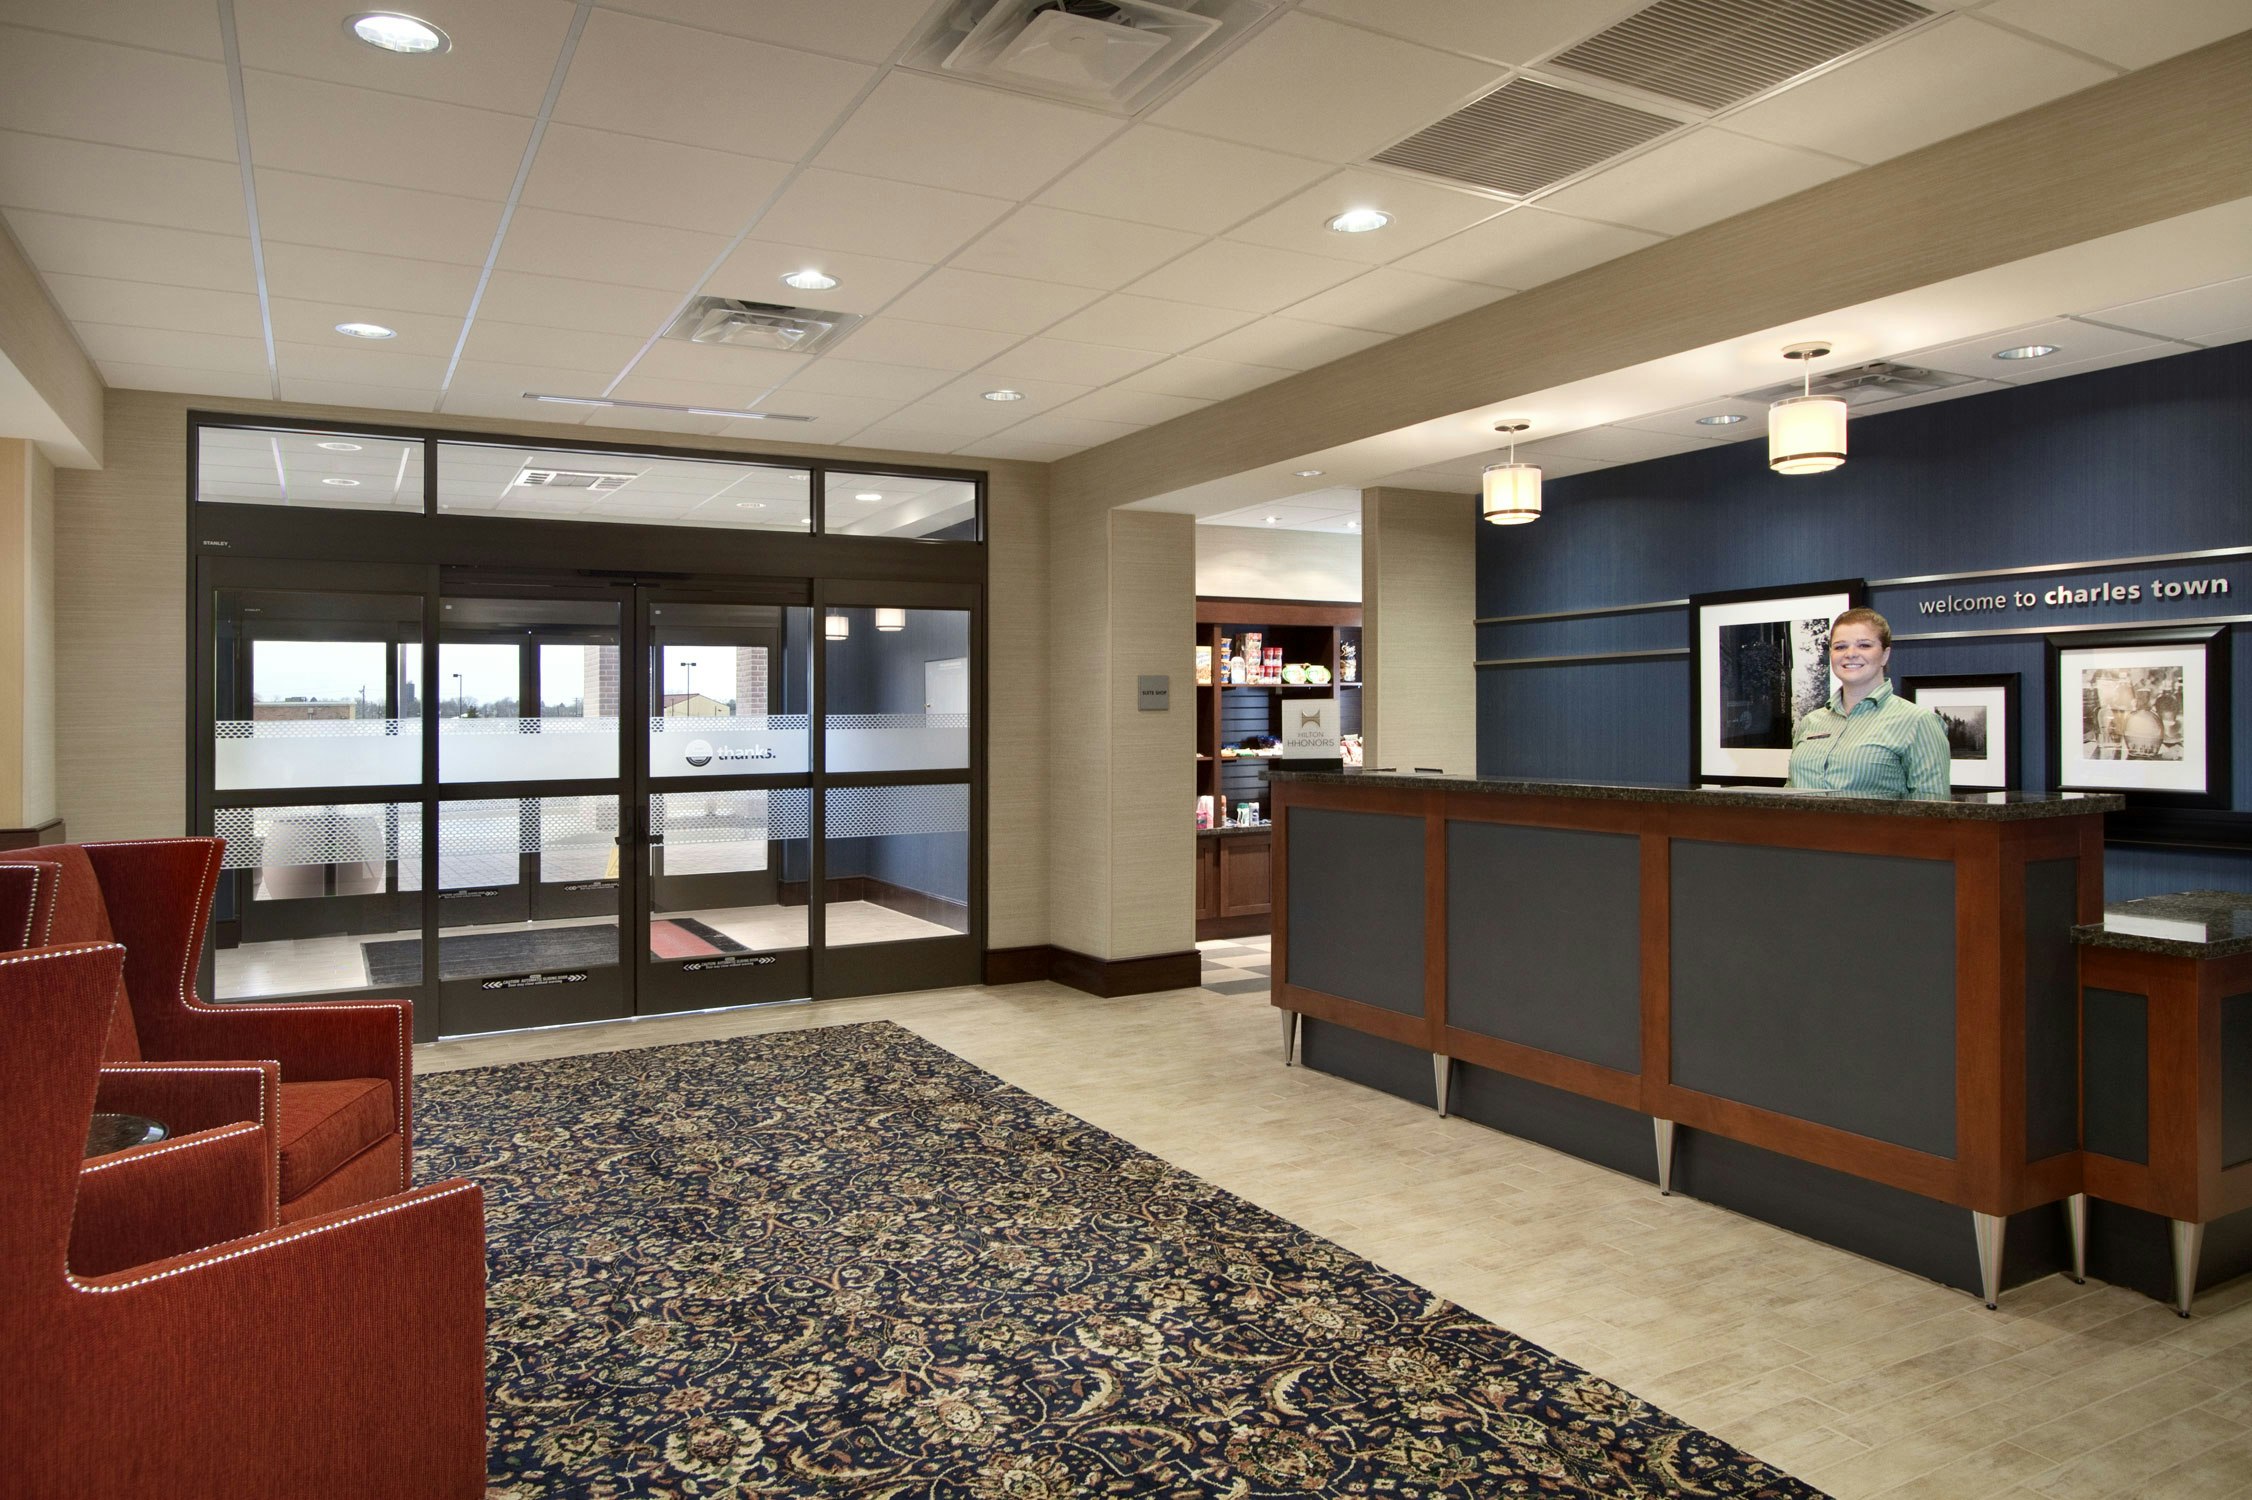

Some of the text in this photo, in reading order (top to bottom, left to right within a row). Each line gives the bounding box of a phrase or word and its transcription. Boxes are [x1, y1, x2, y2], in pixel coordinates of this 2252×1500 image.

[1919, 577, 2229, 614] welcome to charles town
[1287, 739, 1335, 747] HHONORS
